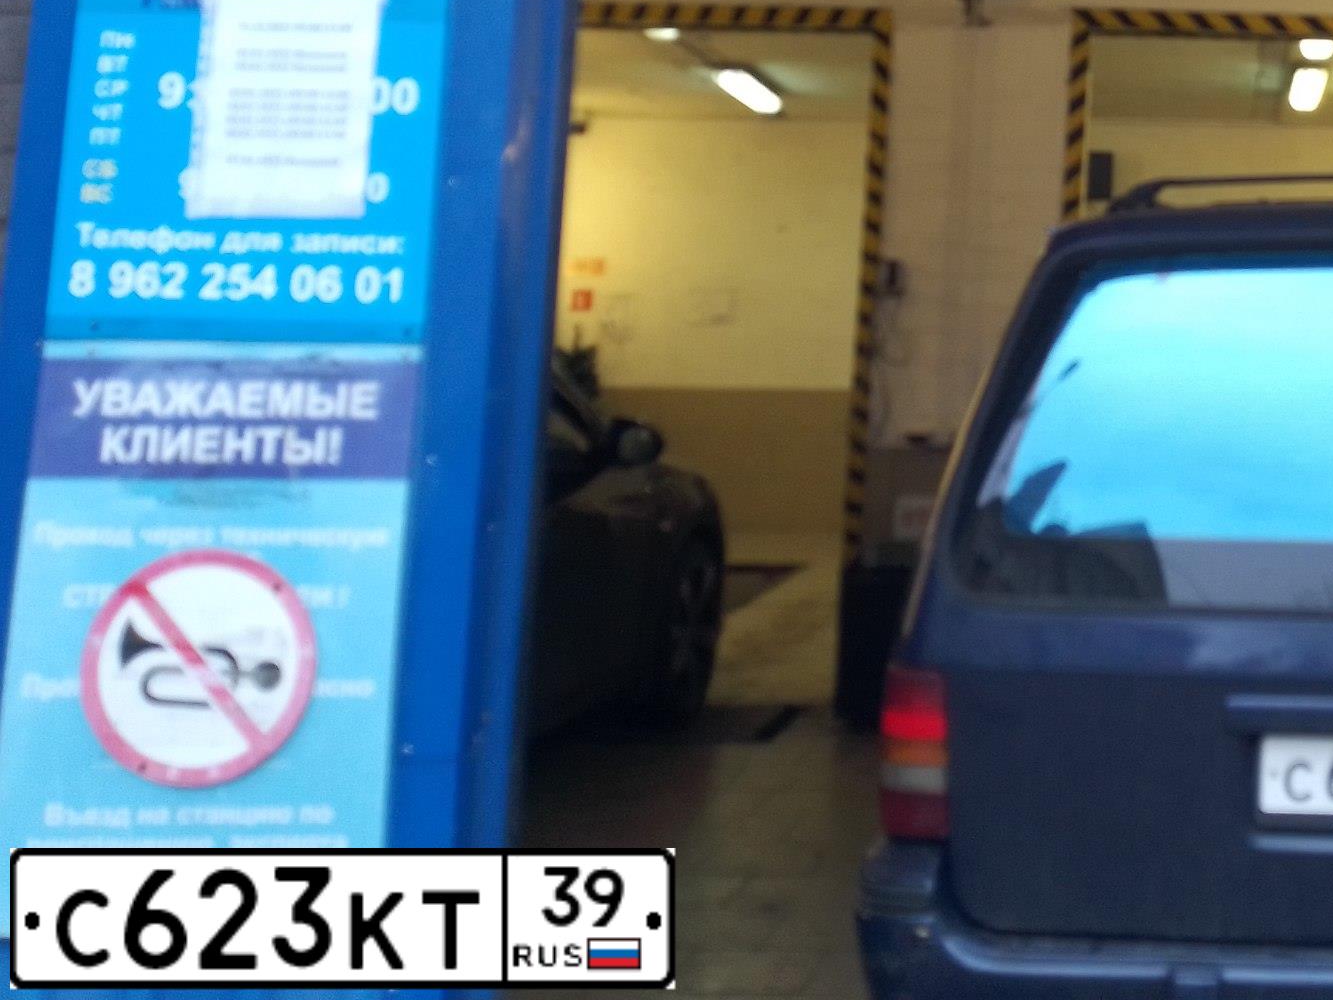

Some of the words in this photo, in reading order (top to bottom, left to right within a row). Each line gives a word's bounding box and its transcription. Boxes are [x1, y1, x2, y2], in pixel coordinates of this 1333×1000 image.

[75, 222, 216, 253] Телефон
[219, 233, 283, 255] для
[291, 234, 404, 256] записи:
[68, 260, 96, 298] 8
[108, 261, 188, 299] 962
[199, 263, 278, 301] 254
[290, 266, 344, 303] 06
[354, 266, 404, 304] 01
[73, 380, 380, 420] УВАЖАЕМЫЕ
[100, 428, 343, 465] КЛИЕНТЫ!
